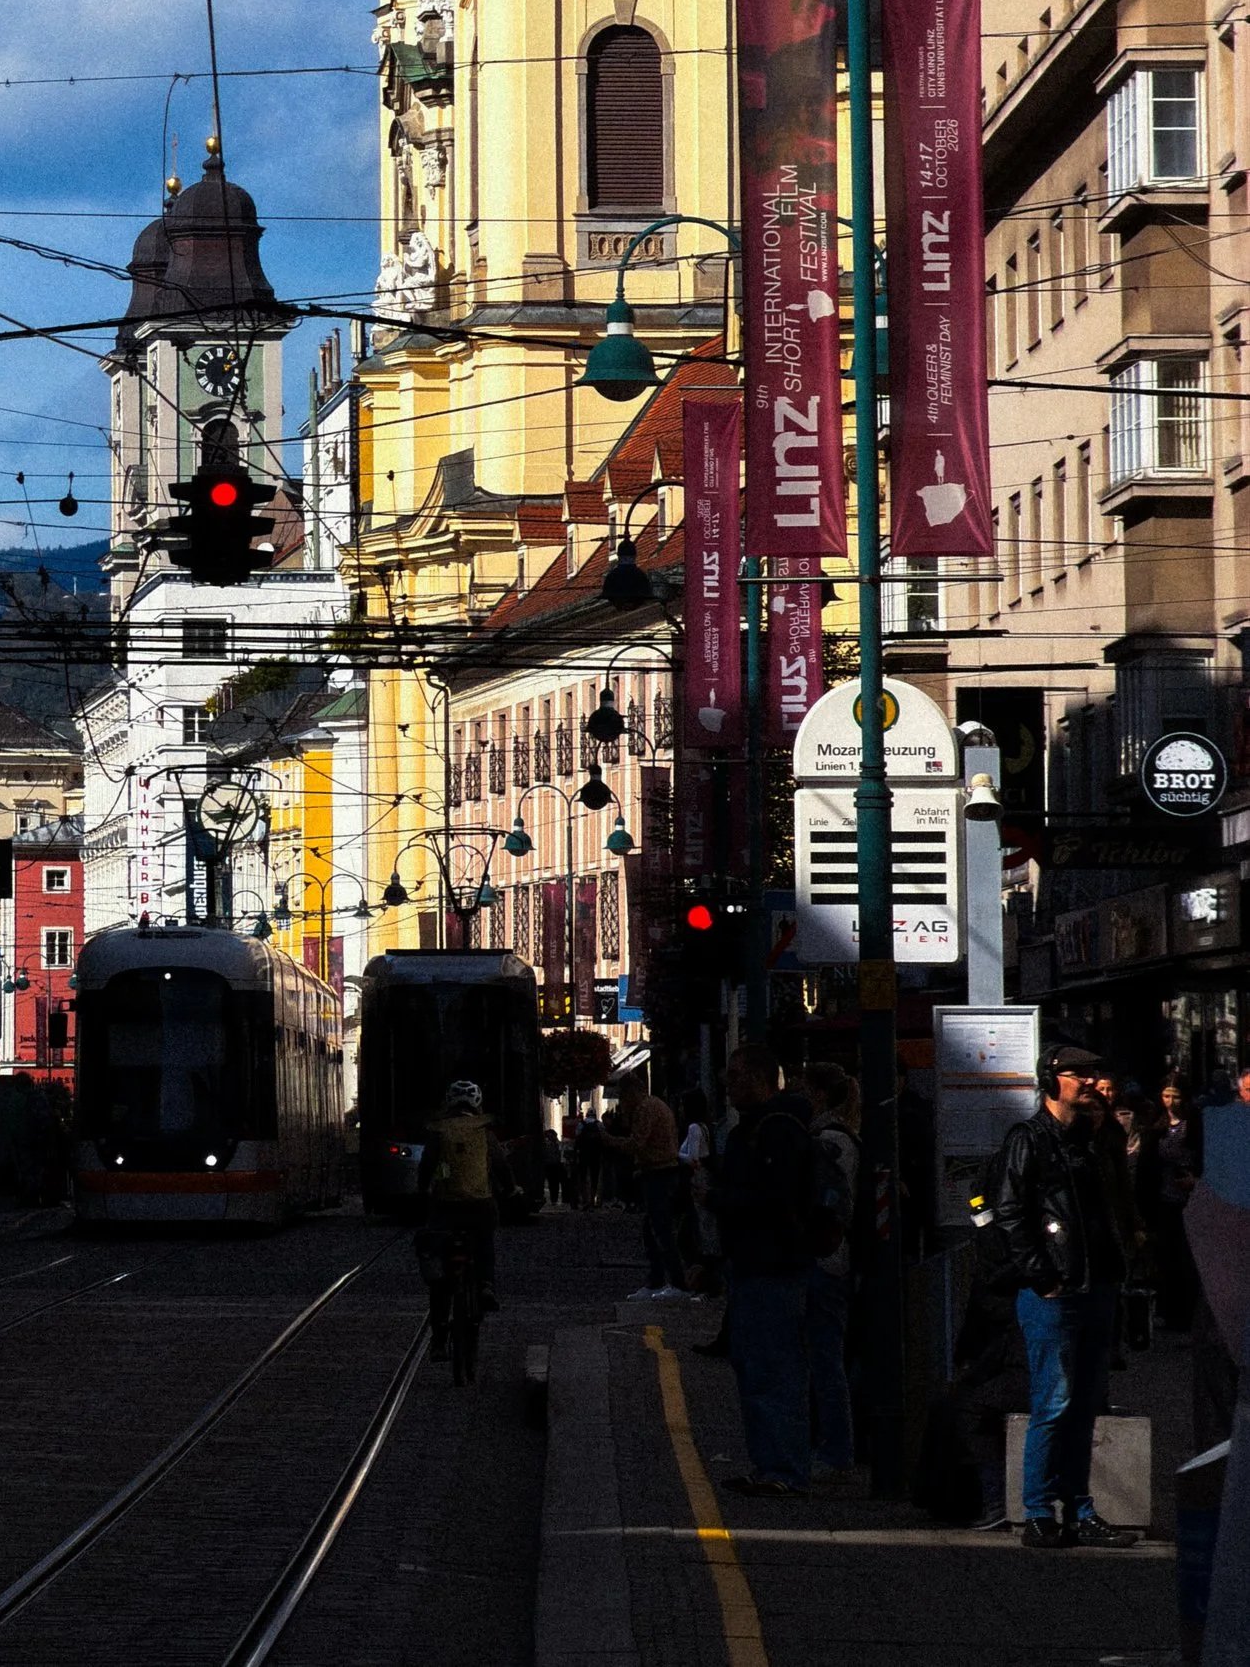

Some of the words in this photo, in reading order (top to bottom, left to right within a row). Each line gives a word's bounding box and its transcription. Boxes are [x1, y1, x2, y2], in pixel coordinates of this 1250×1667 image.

[928, 29, 936, 50] LINZ
[928, 51, 936, 75] KINO
[934, 6, 945, 98] KUNSTUNIVERSITÄT
[928, 76, 936, 98] CITY
[947, 118, 959, 152] 2026
[919, 142, 934, 189] 14-17
[934, 119, 948, 189] OCTOBER
[780, 164, 799, 216] FILM
[799, 181, 818, 282] FESTIVAL
[762, 184, 783, 363] INTERNATIONAL
[939, 315, 951, 343] DAY
[783, 312, 802, 393] SHORT
[927, 343, 938, 352] &
[927, 354, 938, 401] QUEER
[939, 344, 953, 406] FEMINIST
[756, 384, 770, 409] 9th
[928, 403, 938, 424] 4th
[817, 743, 936, 759] Mozareuzung
[816, 761, 846, 771] Linien
[1152, 773, 1216, 789] BROT
[1159, 792, 1210, 806] süchtig
[808, 818, 829, 826] Linie
[842, 818, 857, 826] Ziel
[914, 807, 950, 816] Abfahrt
[916, 817, 926, 825] in
[928, 816, 950, 825] Min.
[852, 920, 907, 932] LZ
[913, 920, 948, 932] AG
